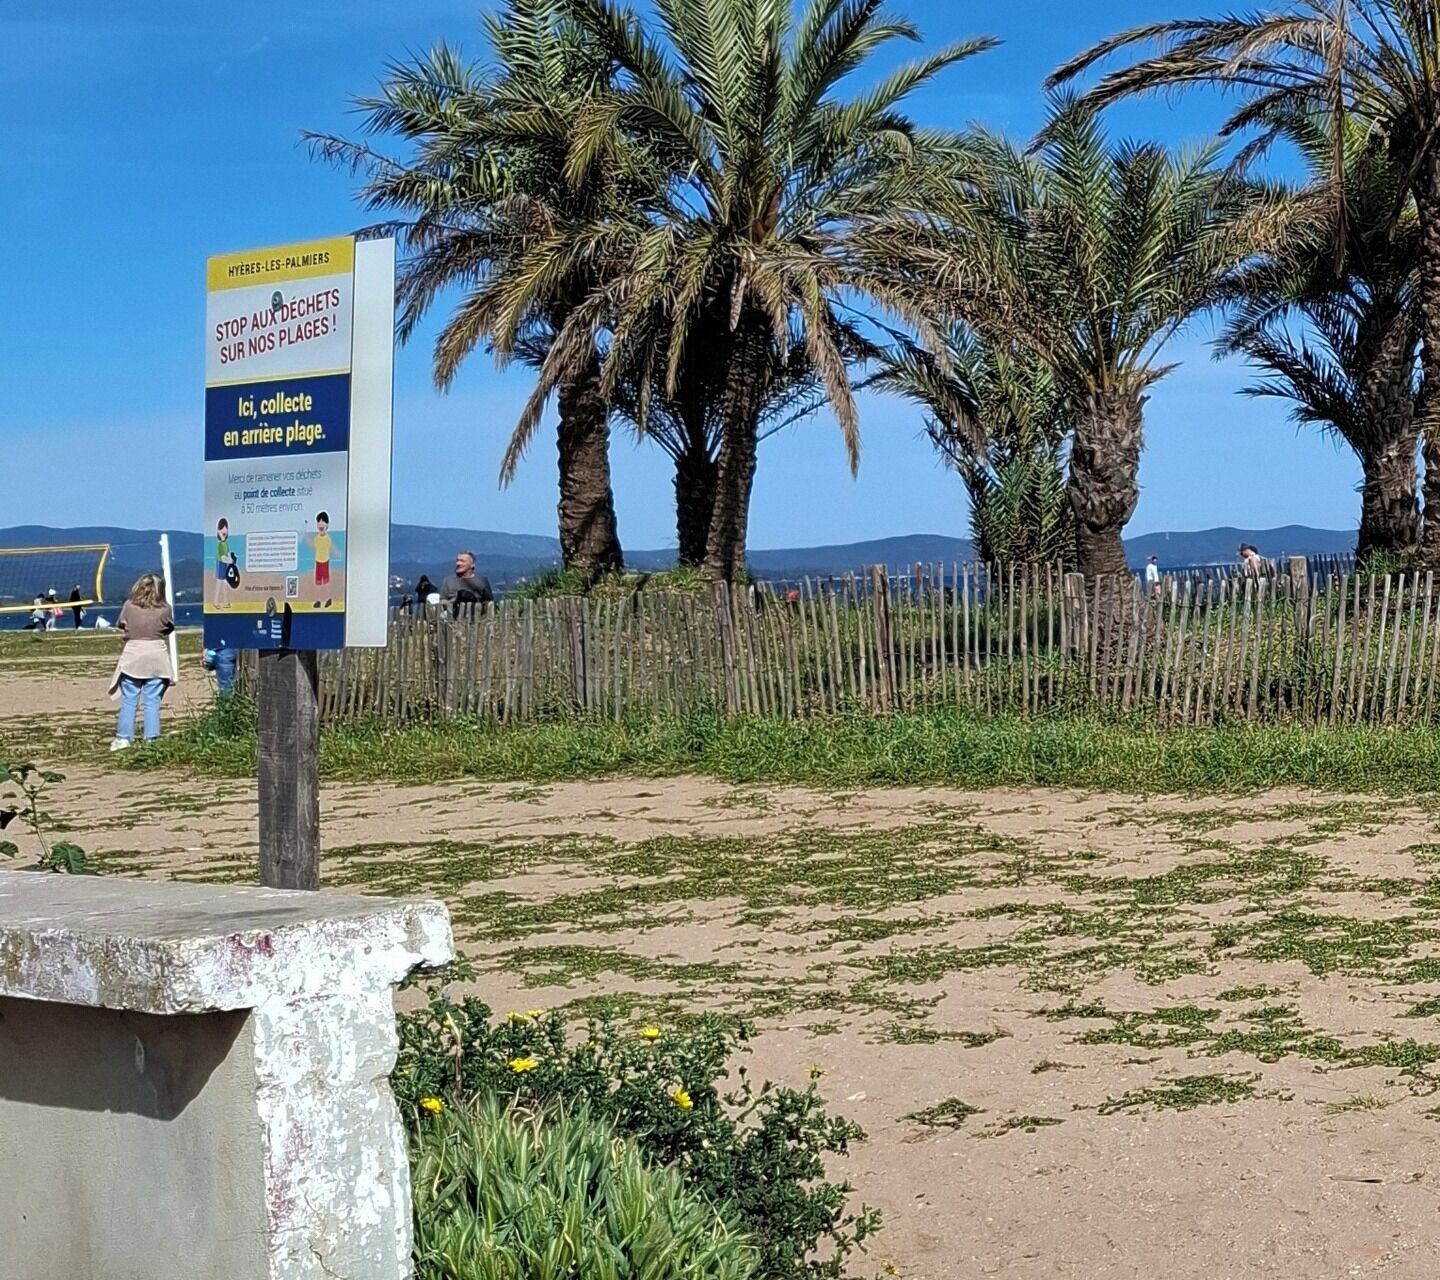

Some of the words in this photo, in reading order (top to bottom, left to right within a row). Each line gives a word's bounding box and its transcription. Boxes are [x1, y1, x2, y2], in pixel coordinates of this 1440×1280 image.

[228, 252, 330, 277] HYÈRES-LES-PALMIERS
[216, 316, 247, 342] STOP
[251, 308, 277, 332] AUX
[281, 288, 340, 322] DÉCHETS
[220, 342, 245, 364] SUR
[249, 332, 275, 356] NOS
[279, 316, 329, 347] PLAGES
[238, 395, 257, 419] Ici,
[261, 392, 312, 414] collecte
[223, 430, 239, 446] en
[241, 422, 283, 445] arrière
[286, 420, 326, 447] plage.
[243, 488, 259, 500] point
[261, 488, 269, 498] de
[270, 486, 295, 497] collecte
